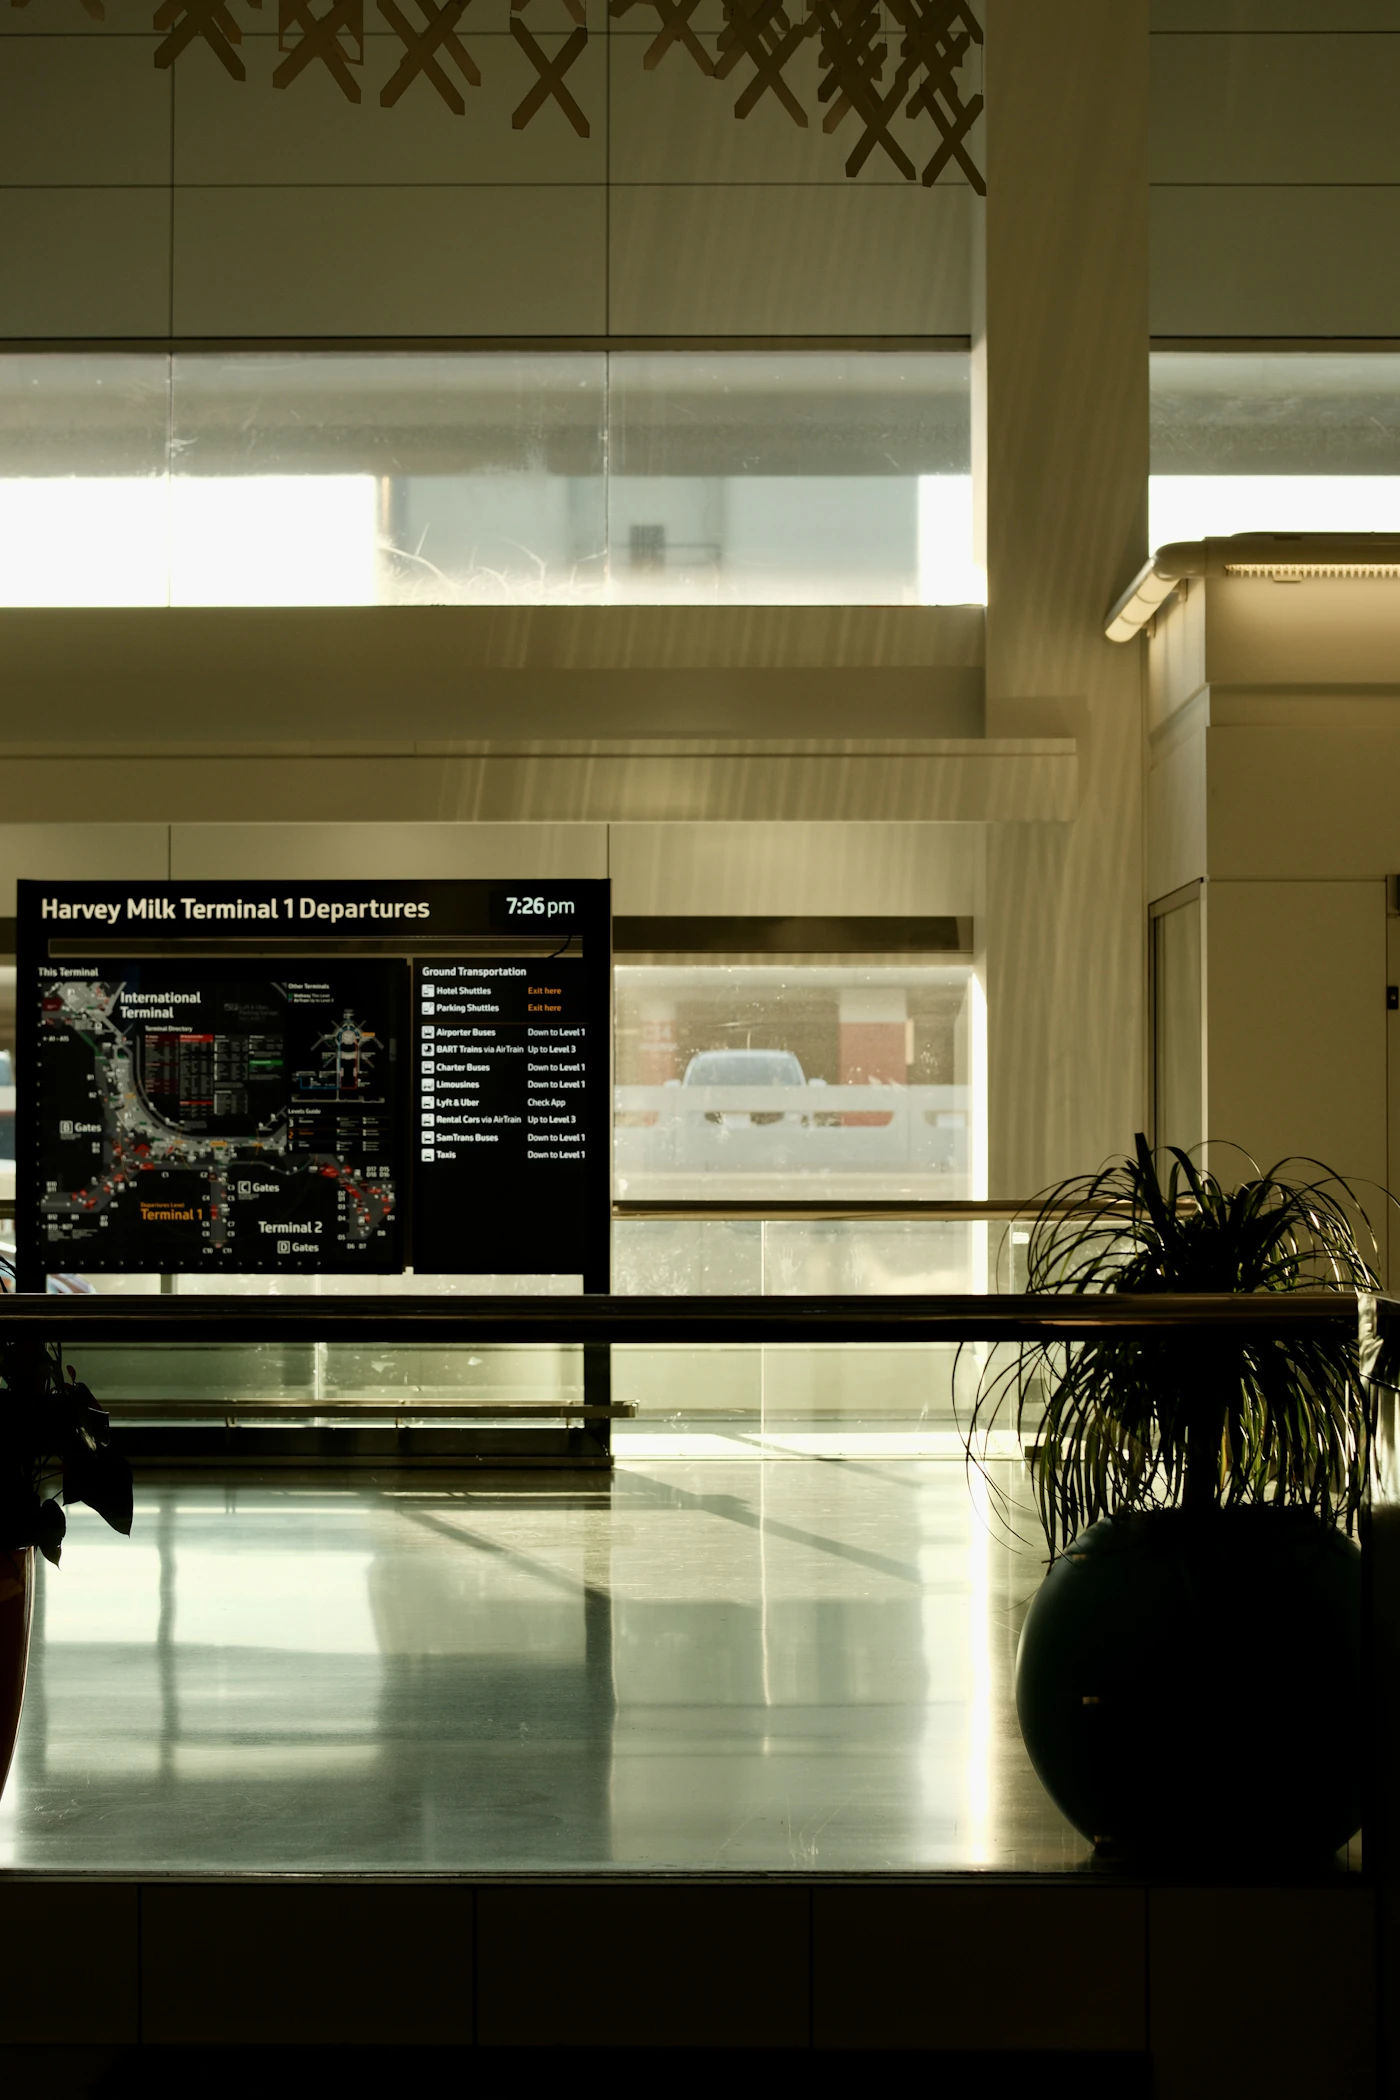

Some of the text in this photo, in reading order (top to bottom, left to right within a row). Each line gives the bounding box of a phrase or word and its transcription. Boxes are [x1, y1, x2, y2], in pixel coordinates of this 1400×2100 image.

[41, 898, 430, 924] Harvey Milk Terminal 1 Departures
[506, 896, 575, 918] 7:26 pm
[37, 967, 99, 977] This Terminal
[422, 966, 527, 978] Ground Transportation
[436, 986, 492, 995] Hotel Shuttles
[528, 986, 562, 995] Exit here
[120, 991, 202, 1004] International
[120, 1006, 174, 1019] Terminal
[436, 1003, 499, 1013] Parking Shuttles
[528, 1003, 562, 1012] Exit here
[168, 1025, 193, 1033] Directory
[436, 1028, 496, 1038] Airporter Buses
[527, 1028, 586, 1036] Down to Level 1
[436, 1045, 524, 1053] BART Trains via AirTrain
[527, 1045, 576, 1055] Up to Level 3
[436, 1063, 491, 1071] Charter Buses
[527, 1063, 586, 1071] Down to Level 1
[436, 1080, 480, 1089] Limousines
[527, 1080, 586, 1088] Down to Level 1
[436, 1098, 480, 1108] Lyft & Uber
[527, 1098, 566, 1108] Check App
[289, 1118, 294, 1128] 3
[436, 1115, 522, 1124] Rental Cars via AirTrain
[527, 1115, 576, 1126] Up to Level 3
[74, 1121, 102, 1133] Gates
[288, 1131, 294, 1139] 2
[436, 1133, 499, 1142] SamTrans Buses
[527, 1133, 586, 1142] Down to Level 1
[289, 1143, 293, 1151] 1
[436, 1150, 456, 1159] Taxis
[527, 1150, 586, 1159] Down to Level 1
[252, 1183, 280, 1193] Gates
[140, 1208, 203, 1220] Terminal 1
[258, 1221, 323, 1234] Terminal 2
[292, 1242, 320, 1253] Gates
